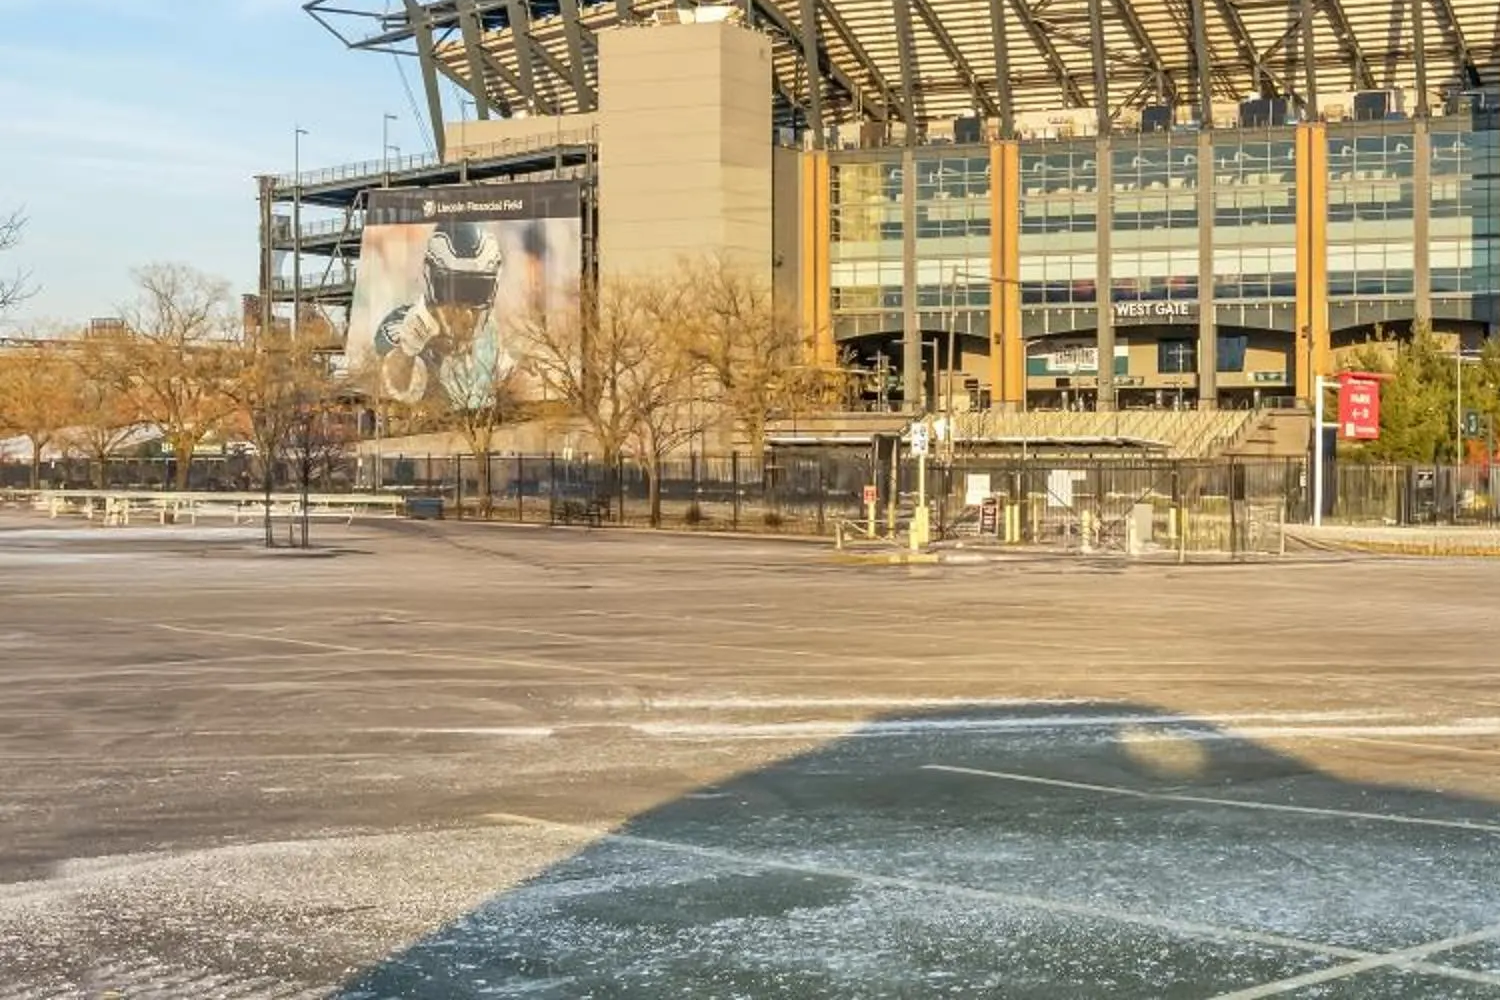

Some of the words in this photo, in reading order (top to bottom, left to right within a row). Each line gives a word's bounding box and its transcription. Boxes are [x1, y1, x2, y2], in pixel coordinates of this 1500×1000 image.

[503, 199, 523, 211] Field
[1115, 302, 1152, 317] WEST
[1155, 301, 1189, 316] GATE
